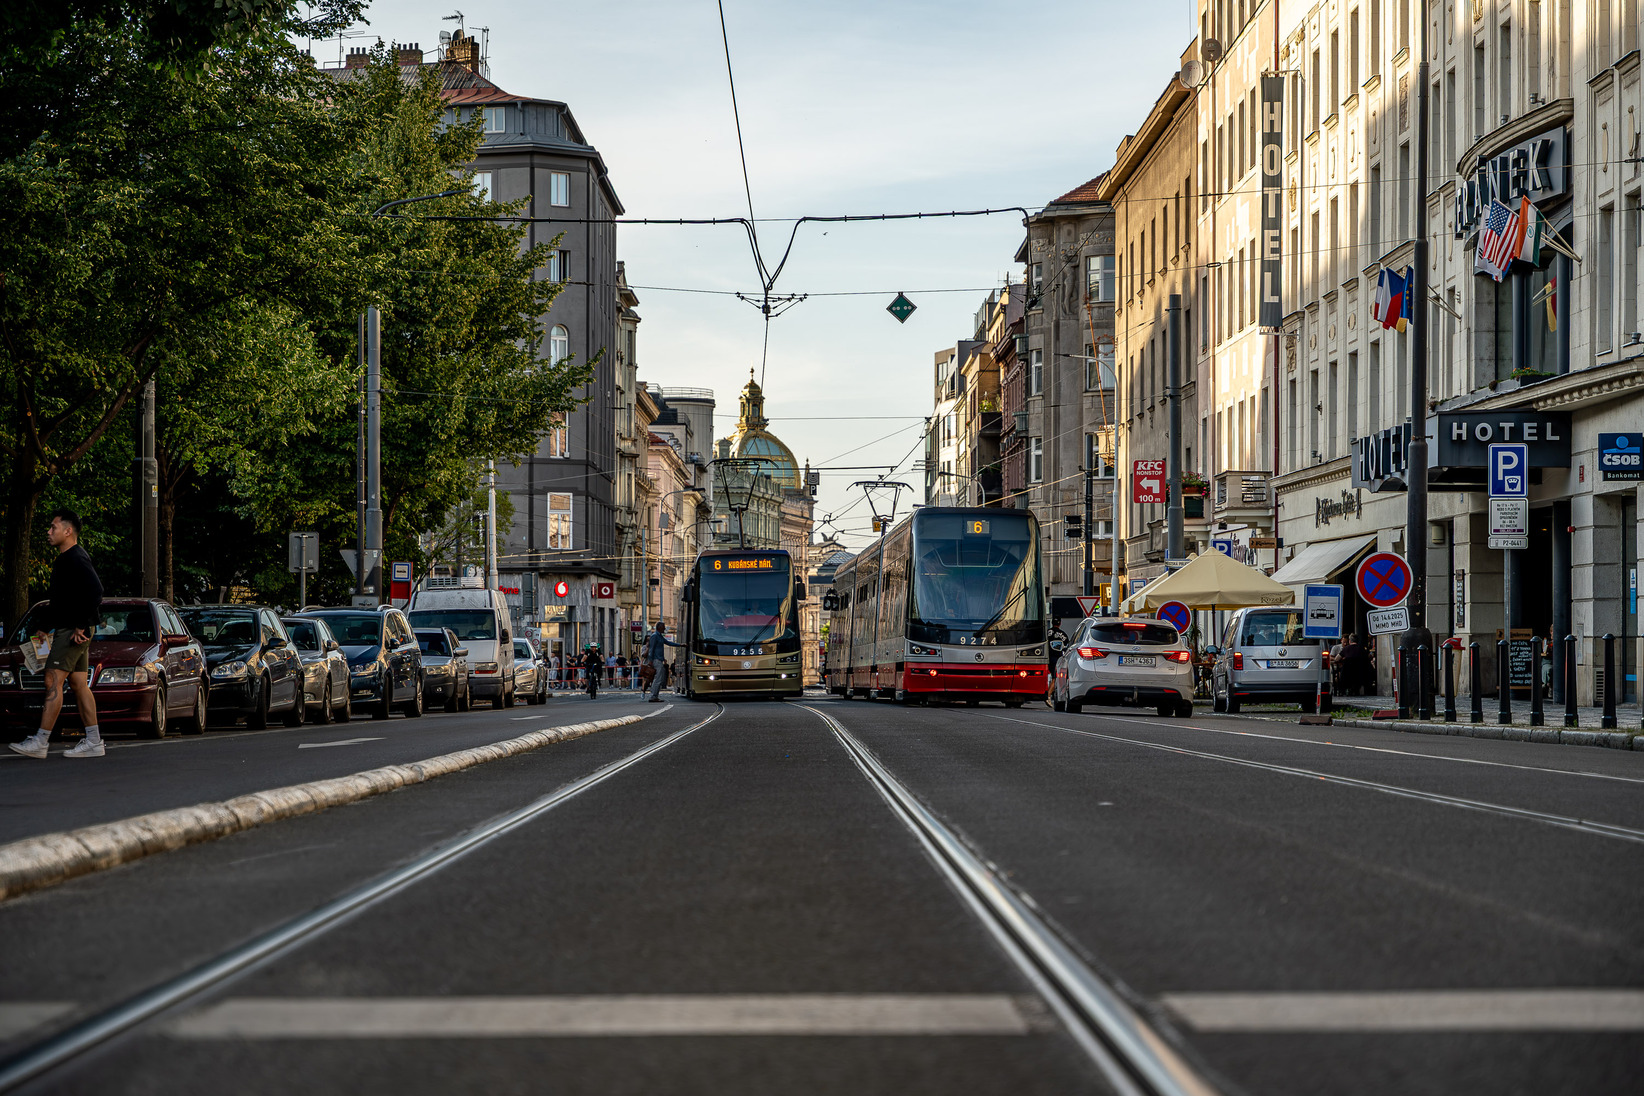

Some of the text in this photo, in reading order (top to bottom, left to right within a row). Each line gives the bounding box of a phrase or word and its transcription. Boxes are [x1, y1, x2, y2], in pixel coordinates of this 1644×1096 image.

[1263, 101, 1281, 303] HOTEL
[1452, 422, 1560, 441] HOTEL
[1359, 423, 1410, 481] HOTEL
[1497, 451, 1519, 480] P
[1602, 453, 1640, 466] ČSOB
[1136, 461, 1163, 471] KFC
[810, 485, 817, 495] P
[1138, 494, 1154, 503] 100
[973, 520, 983, 534] 6
[1215, 542, 1229, 554] P
[714, 558, 773, 570] 6 KUBÁNSKÉ NÁM.
[960, 636, 998, 646] 9274
[733, 647, 763, 656] 9255
